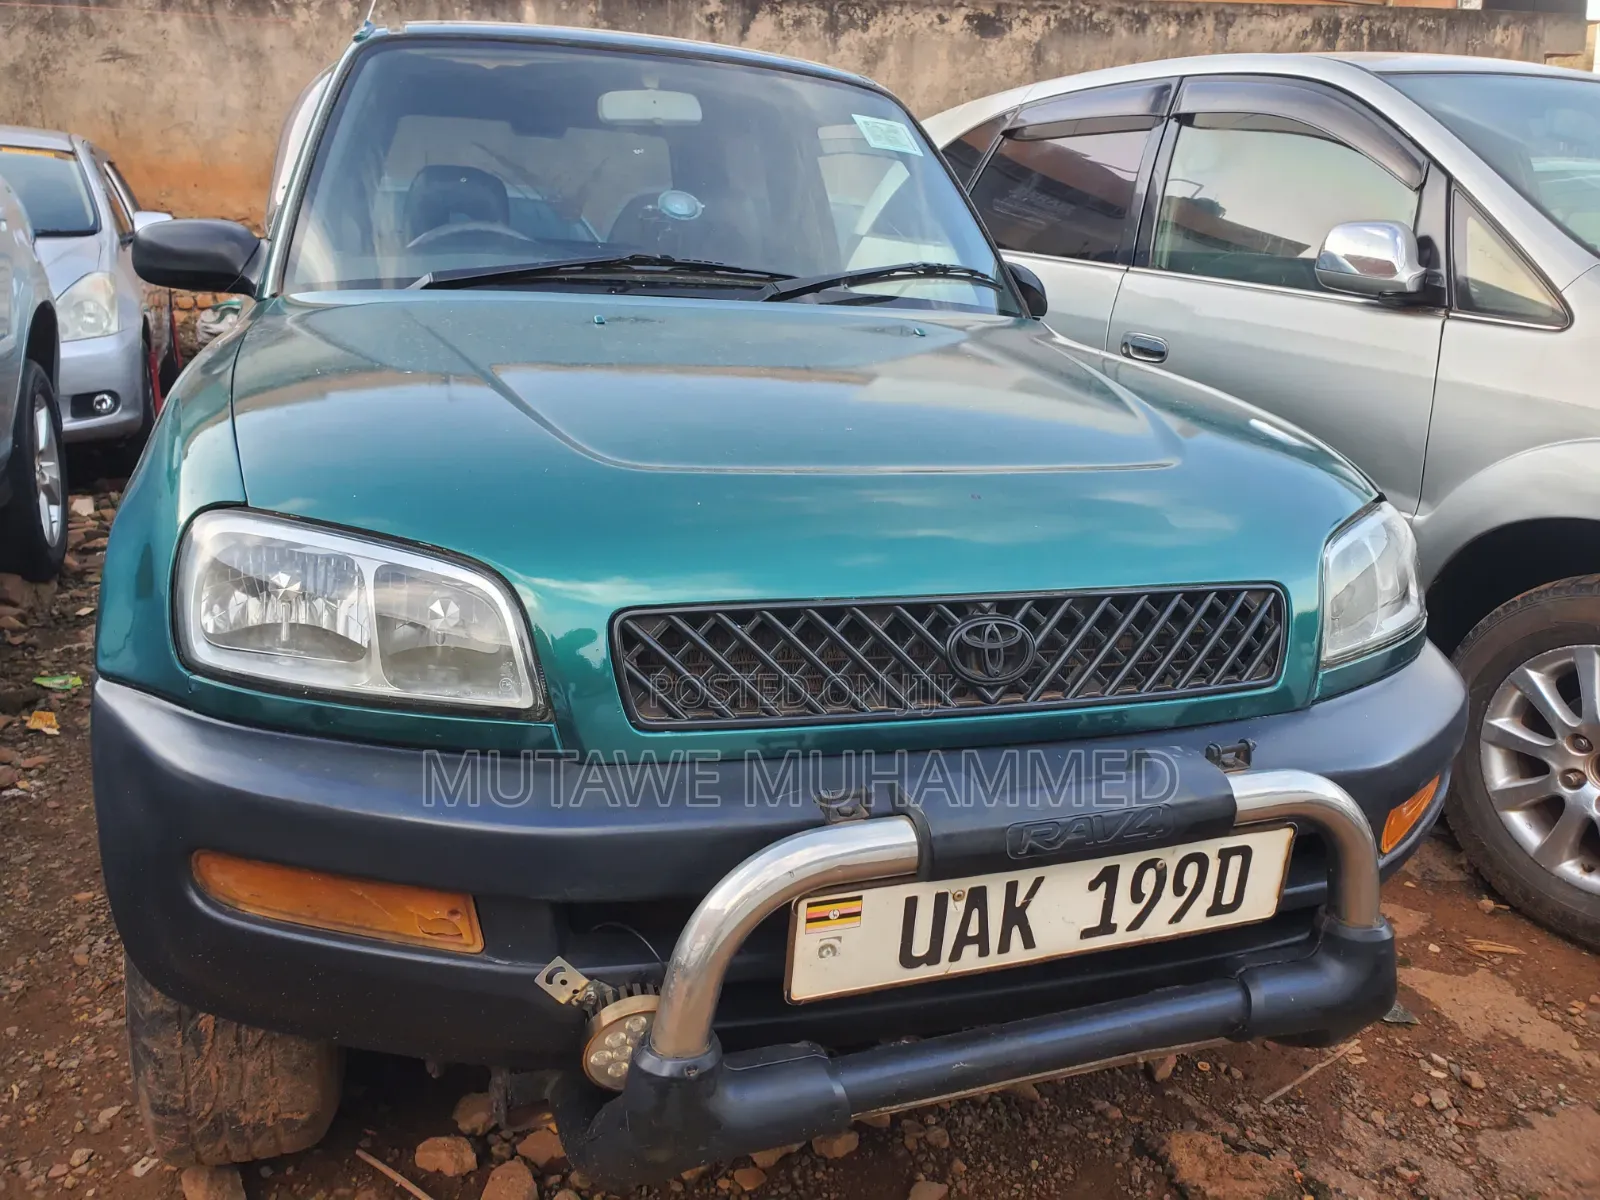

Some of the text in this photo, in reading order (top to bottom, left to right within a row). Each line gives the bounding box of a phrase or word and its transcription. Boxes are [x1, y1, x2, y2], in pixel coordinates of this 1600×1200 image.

[1016, 803, 1172, 855] RAV4
[899, 844, 1254, 969] UAK 199D
